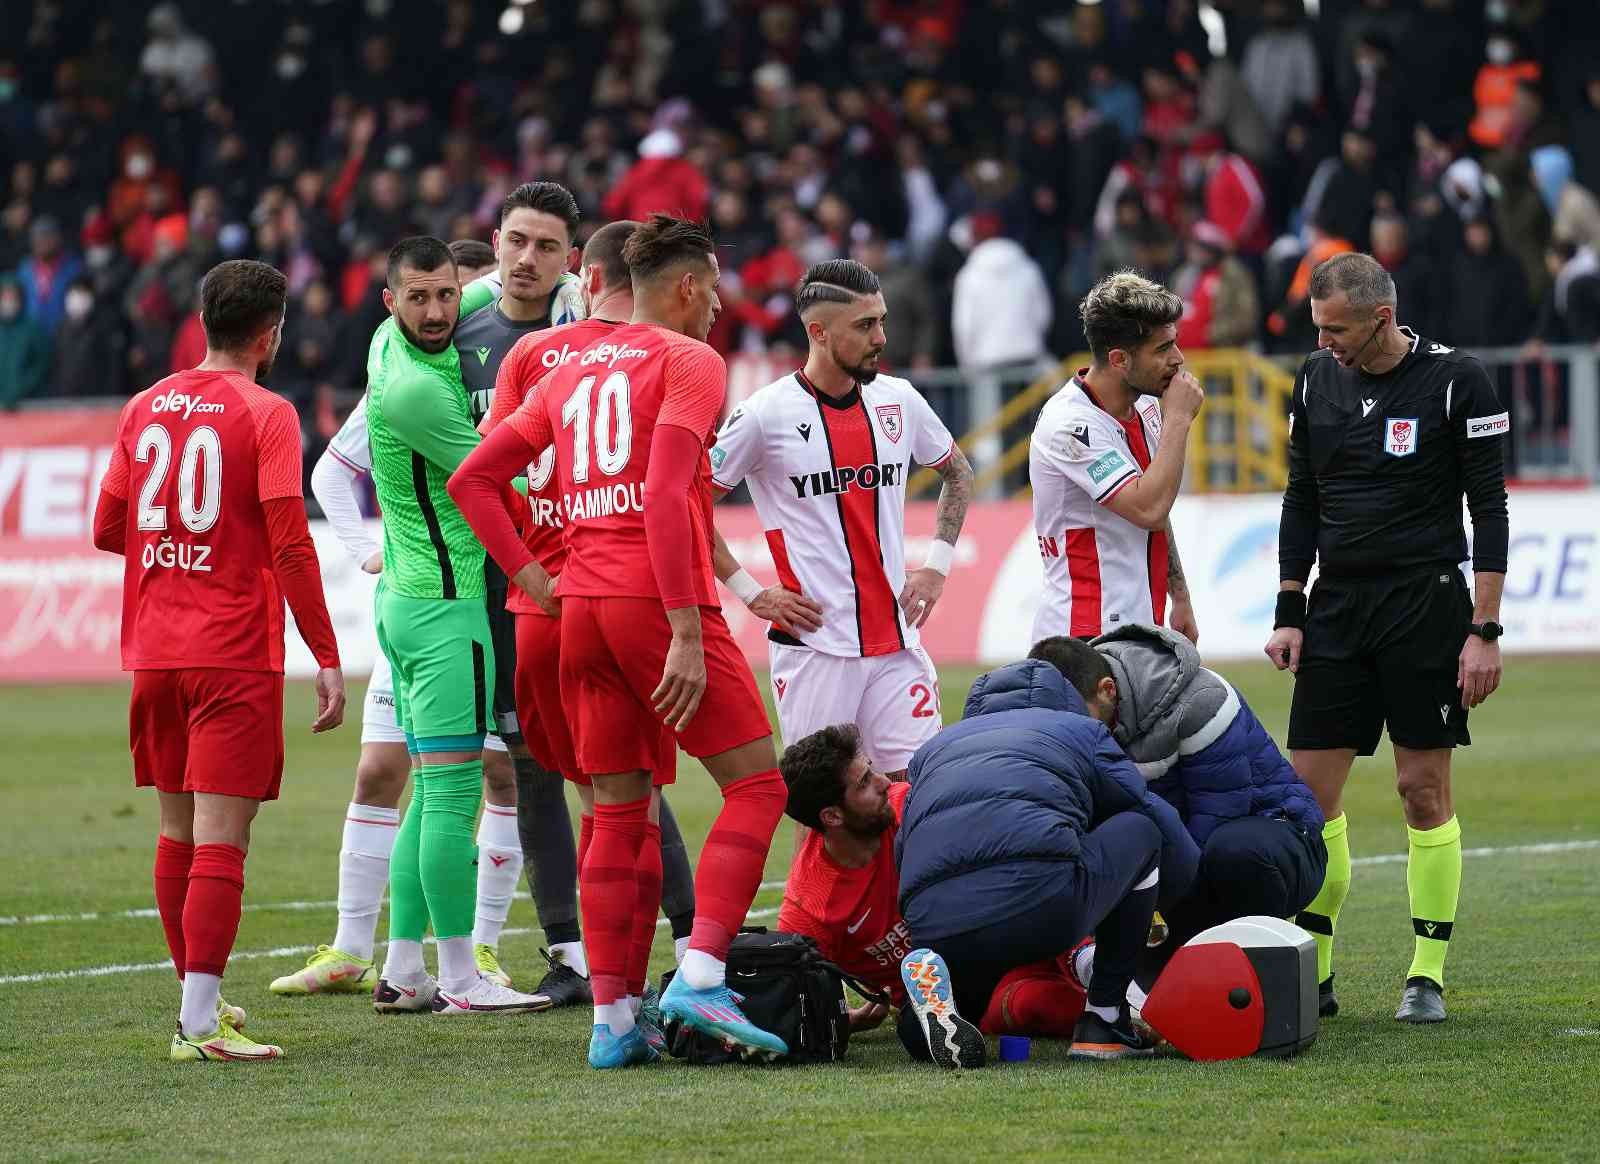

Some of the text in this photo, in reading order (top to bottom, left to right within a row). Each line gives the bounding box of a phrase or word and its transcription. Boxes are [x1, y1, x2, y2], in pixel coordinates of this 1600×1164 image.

[580, 341, 648, 369] oley.com
[151, 389, 225, 420] oley.com
[561, 370, 633, 484] 10
[1391, 444, 1410, 453] TFF
[135, 423, 223, 533] 20
[788, 462, 903, 499] YILPORT
[141, 536, 212, 572] OĞUZ
